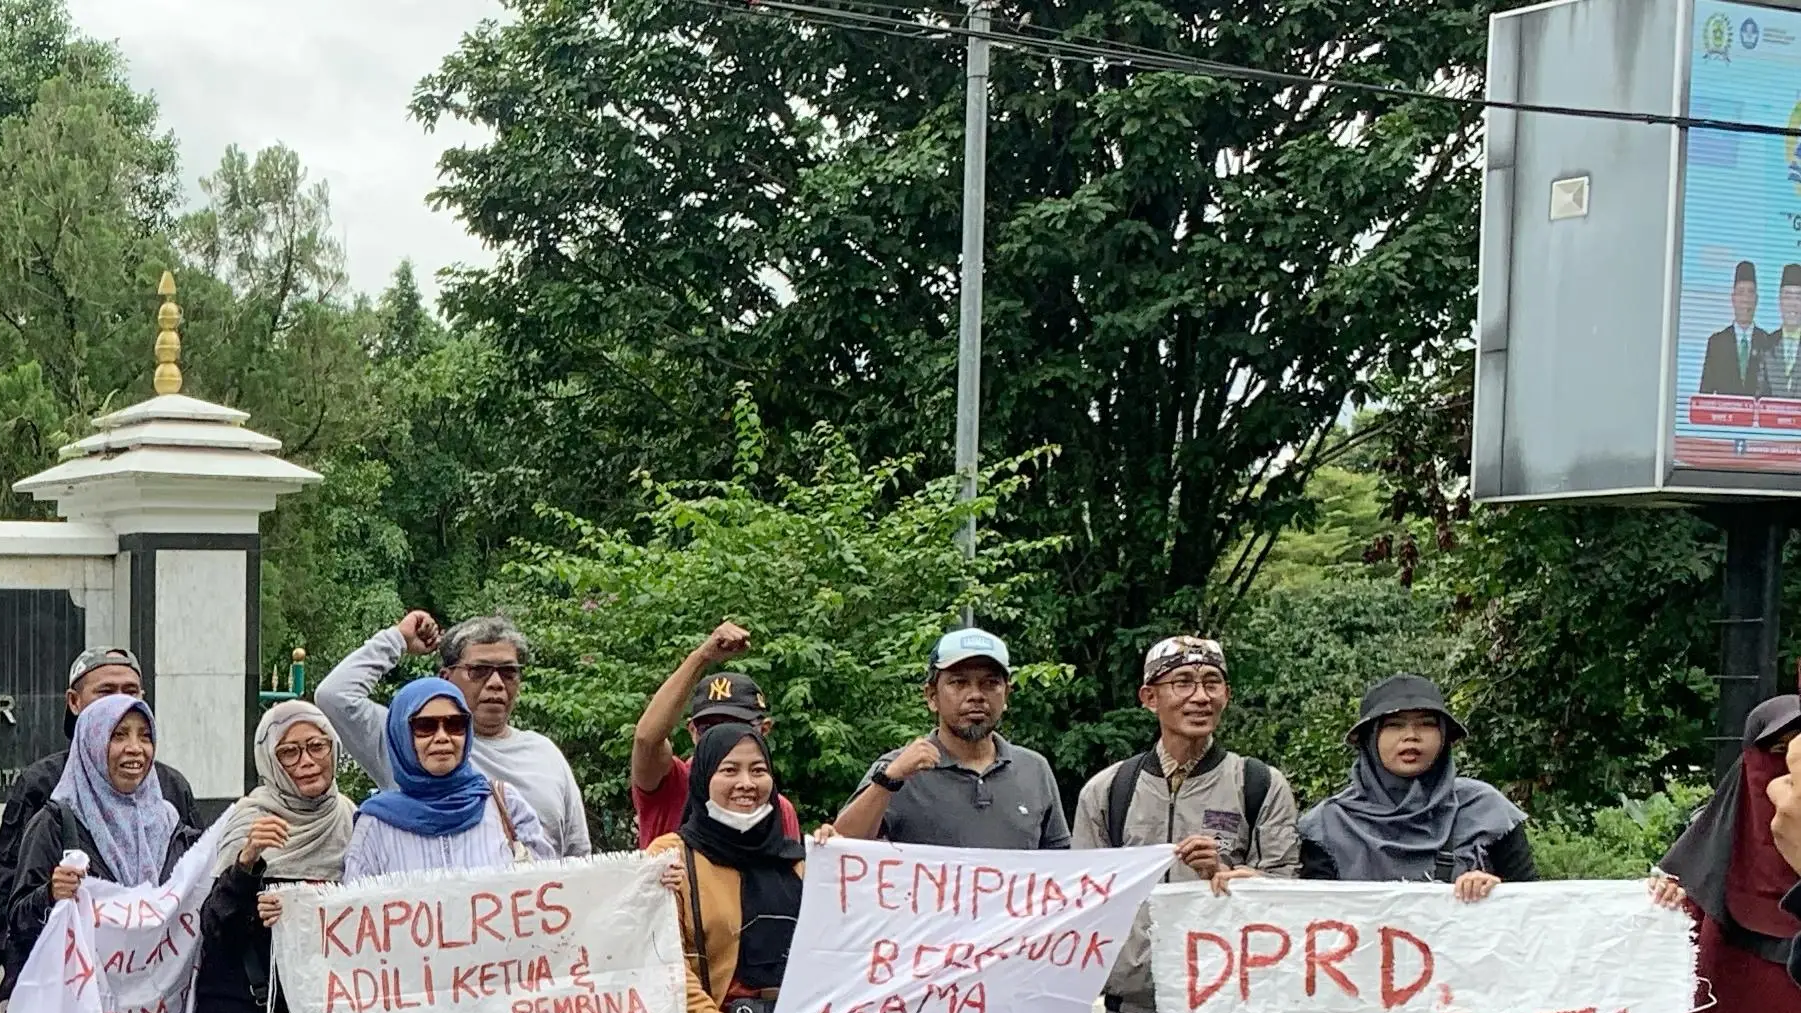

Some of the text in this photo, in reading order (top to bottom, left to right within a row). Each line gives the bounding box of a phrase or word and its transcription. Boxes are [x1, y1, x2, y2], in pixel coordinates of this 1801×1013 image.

[319, 881, 572, 958] KAPOLRES
[838, 854, 1117, 920] PENIPUAN
[452, 955, 555, 1004] KETUA
